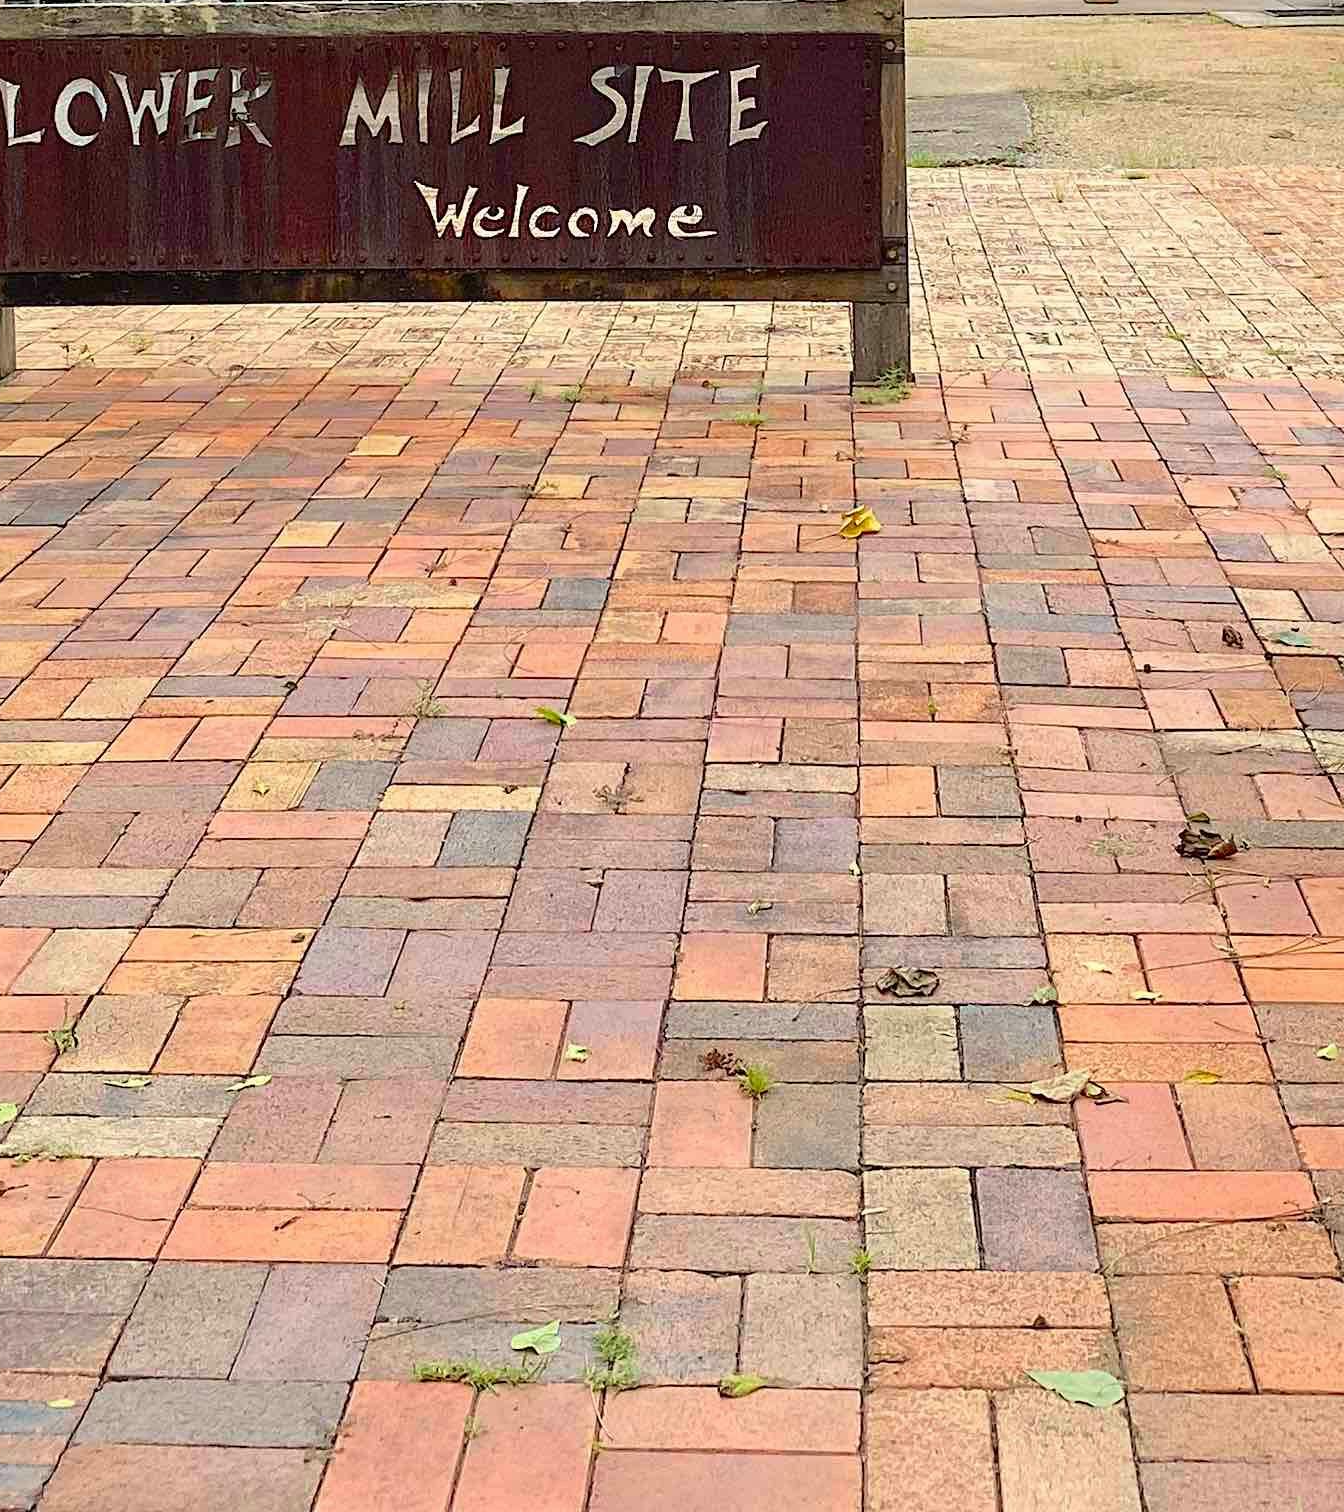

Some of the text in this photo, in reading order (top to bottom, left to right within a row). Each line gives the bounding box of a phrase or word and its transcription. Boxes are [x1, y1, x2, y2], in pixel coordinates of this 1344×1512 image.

[339, 65, 526, 148] MILL
[573, 64, 769, 148] SITE
[412, 180, 718, 240] Welcome
